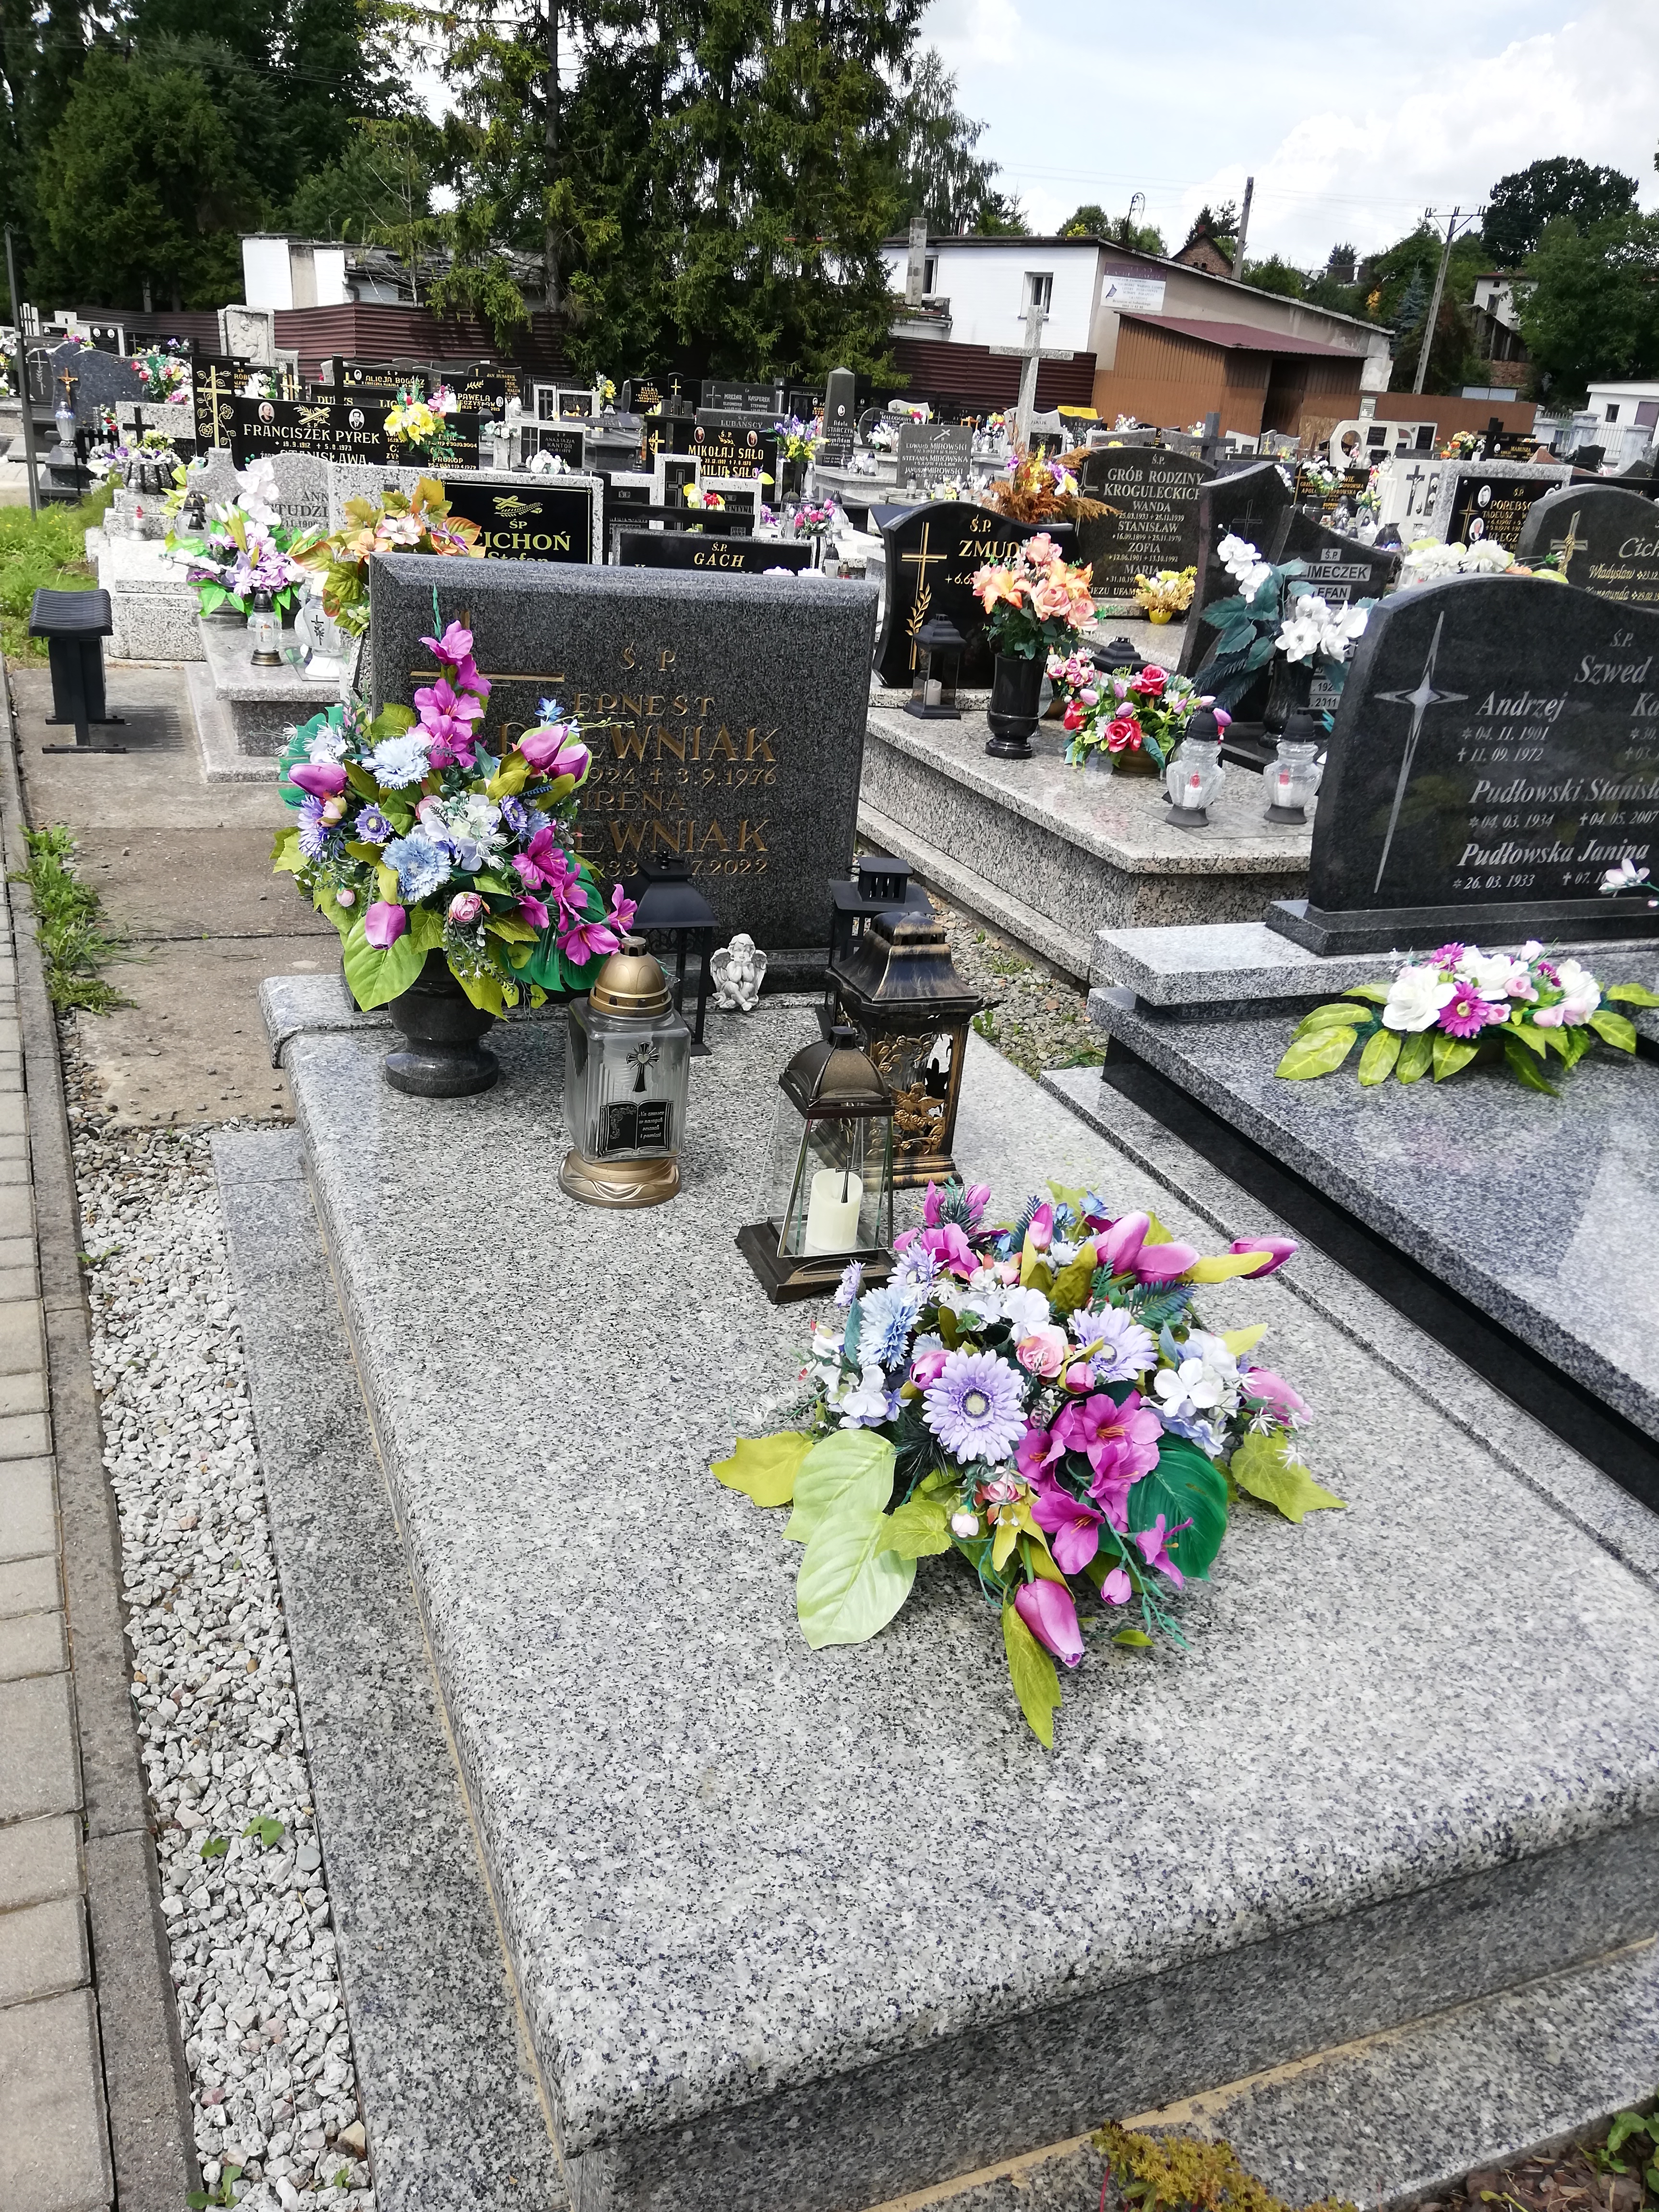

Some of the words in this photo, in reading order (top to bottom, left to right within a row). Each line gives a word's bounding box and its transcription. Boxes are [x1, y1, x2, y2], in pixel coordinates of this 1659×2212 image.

[365, 375, 392, 383] ALICJA
[395, 377, 425, 385] BOGAZ
[457, 393, 490, 402] PAWELA
[243, 424, 331, 441] FRANCISZEK
[336, 430, 381, 444] PYREK
[688, 445, 734, 458] MIKOŁAJ
[738, 448, 764, 460] SAŁO
[1152, 454, 1165, 465] Ś.P.
[700, 464, 728, 476] MILIA
[1107, 465, 1143, 481] GRÓB
[1148, 470, 1204, 485] RODZINY
[301, 491, 329, 502] ANN
[724, 505, 752, 514] ENTYNA
[1132, 501, 1171, 512] WANDA
[1155, 513, 1185, 522] 25.11.1939
[1482, 510, 1514, 519] TADEUSZ
[1118, 520, 1179, 533] STANISŁAW
[479, 531, 571, 551] ICHOŃ
[1116, 533, 1146, 541] 16.09.1899
[1152, 534, 1182, 542] 25.11.1970
[1488, 532, 1519, 542] KŁECZ
[711, 541, 727, 552] Ś.P.
[959, 540, 1020, 559] ZMUD
[1128, 542, 1161, 553] ZOFIA
[694, 552, 745, 567] GACH
[1124, 564, 1159, 575] MARIA
[1303, 565, 1368, 579] IMECZEK
[1642, 570, 1659, 580] 23.12.
[1089, 587, 1110, 595] JEZU
[1113, 587, 1137, 596] UFAM
[1312, 587, 1347, 599] EFAN
[1637, 591, 1659, 601] 29.02.19
[1574, 655, 1653, 685] Szwed
[574, 693, 716, 717] ERNEST
[1475, 690, 1569, 722] Andrzej
[1518, 726, 1550, 741] 1901
[1513, 747, 1544, 762] 1972
[677, 766, 777, 791] 3.9.1976
[1468, 778, 1585, 804] Pudłowski
[1586, 777, 1659, 802] Stanisł
[582, 790, 686, 812] IRENA
[1524, 814, 1555, 828] 1934
[575, 818, 769, 854] EWNIAK
[1456, 840, 1575, 866] Pudłowska
[1577, 839, 1650, 862] Janina
[1506, 874, 1536, 888] 1933
